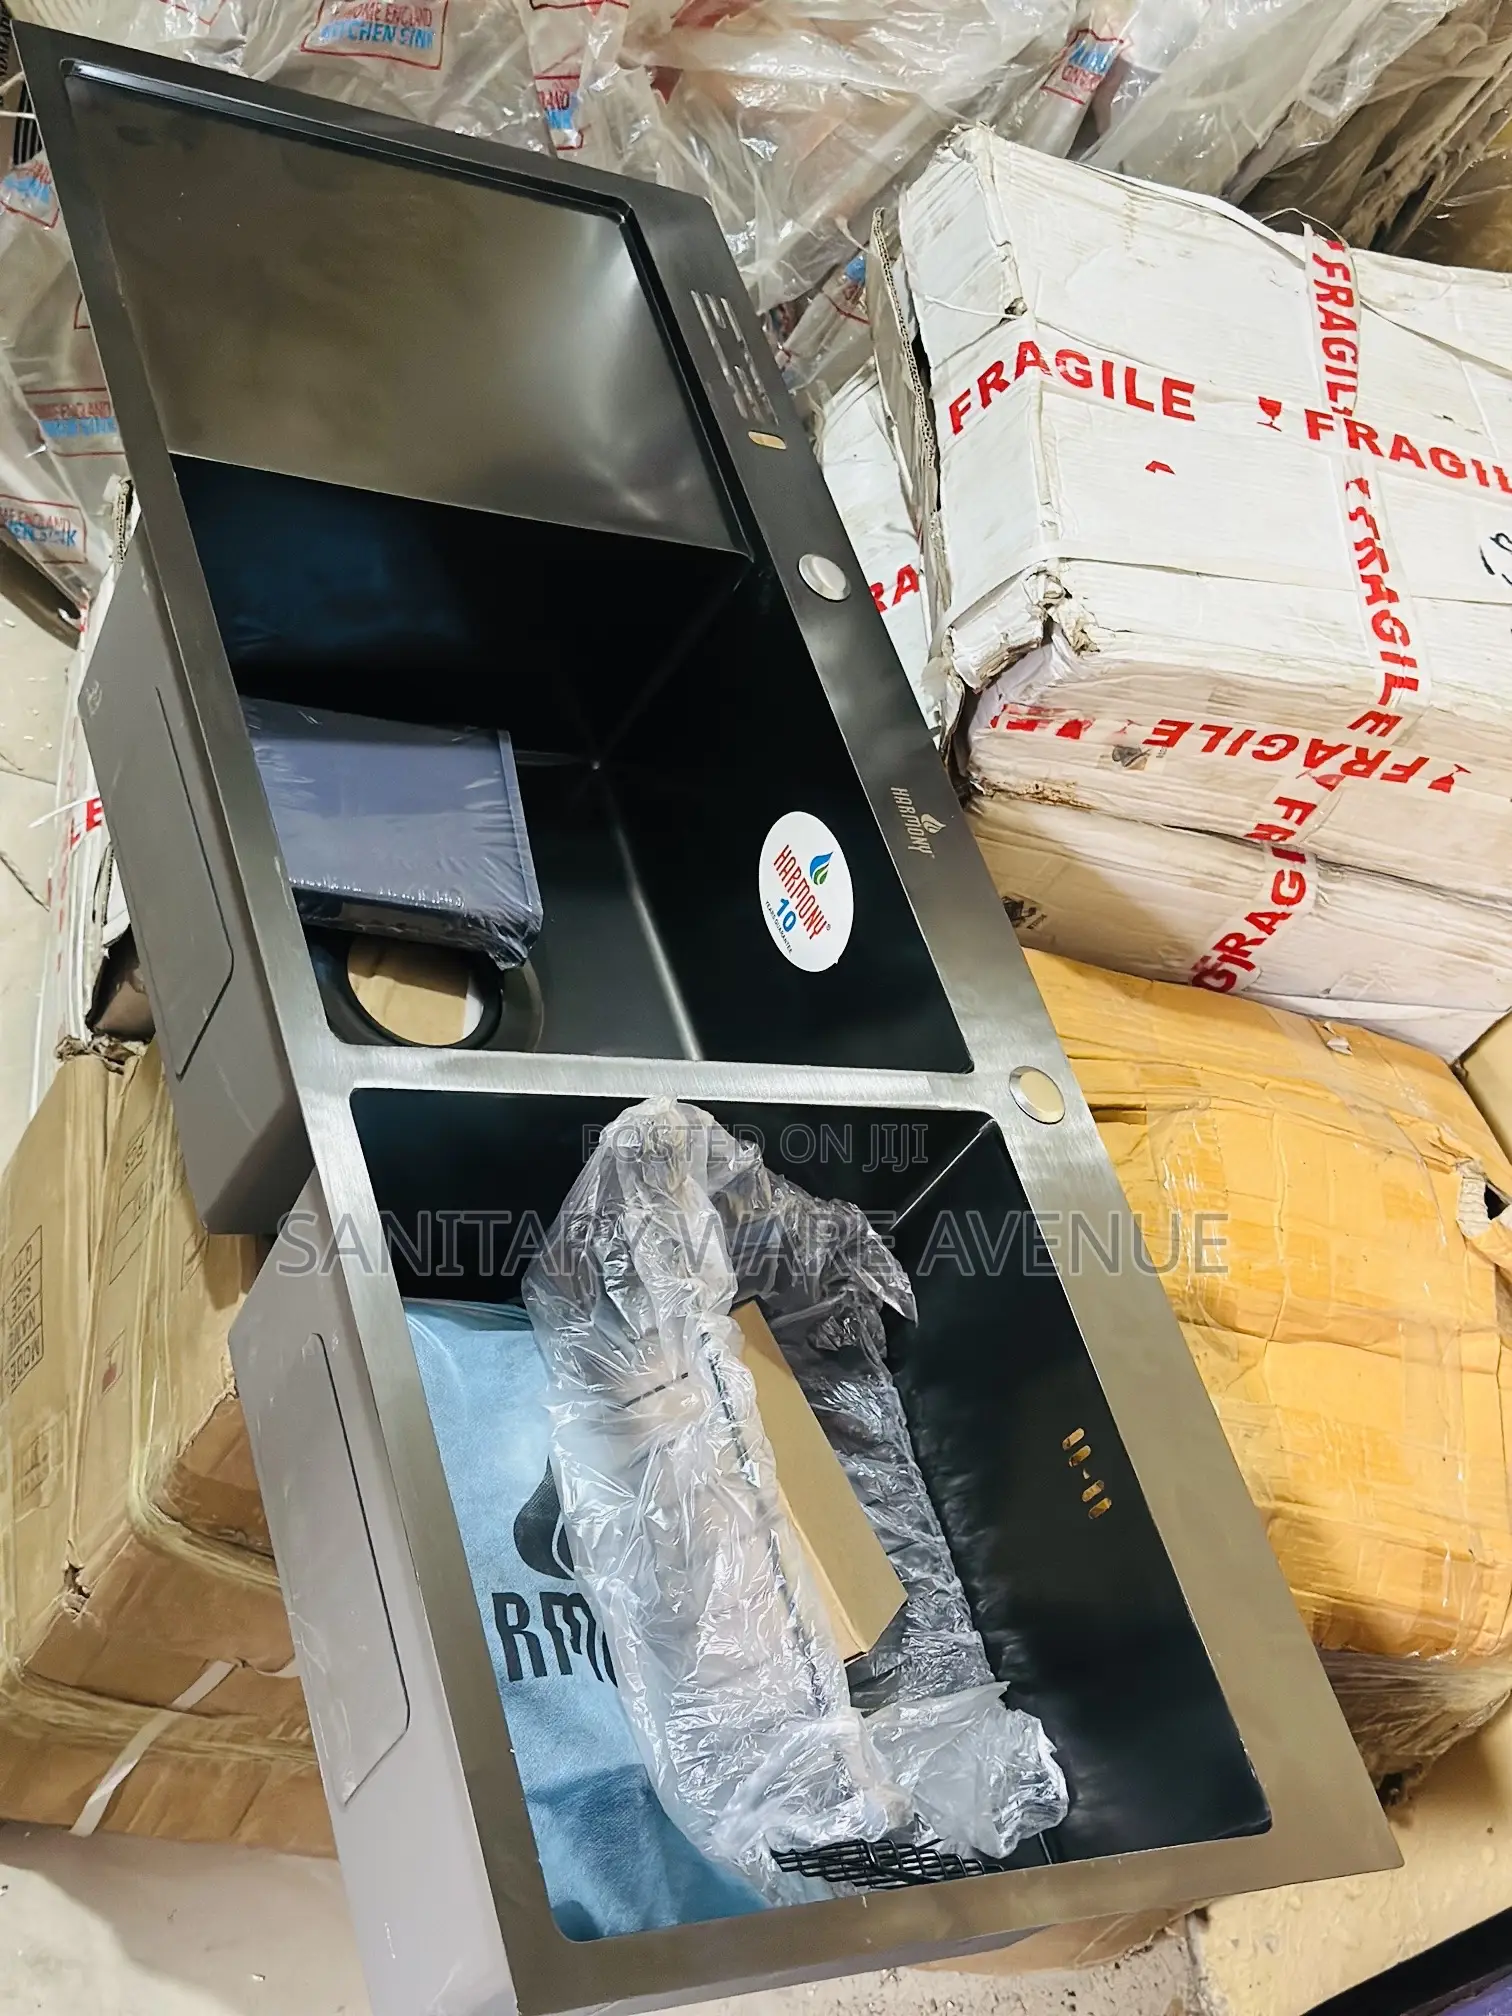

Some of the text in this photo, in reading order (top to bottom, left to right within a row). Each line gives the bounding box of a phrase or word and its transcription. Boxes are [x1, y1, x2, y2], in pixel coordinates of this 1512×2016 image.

[949, 341, 1195, 435] FRAGILE
[1143, 719, 1430, 784] FRAGILE
[891, 786, 934, 855] HARMONY
[777, 898, 798, 934] 10
